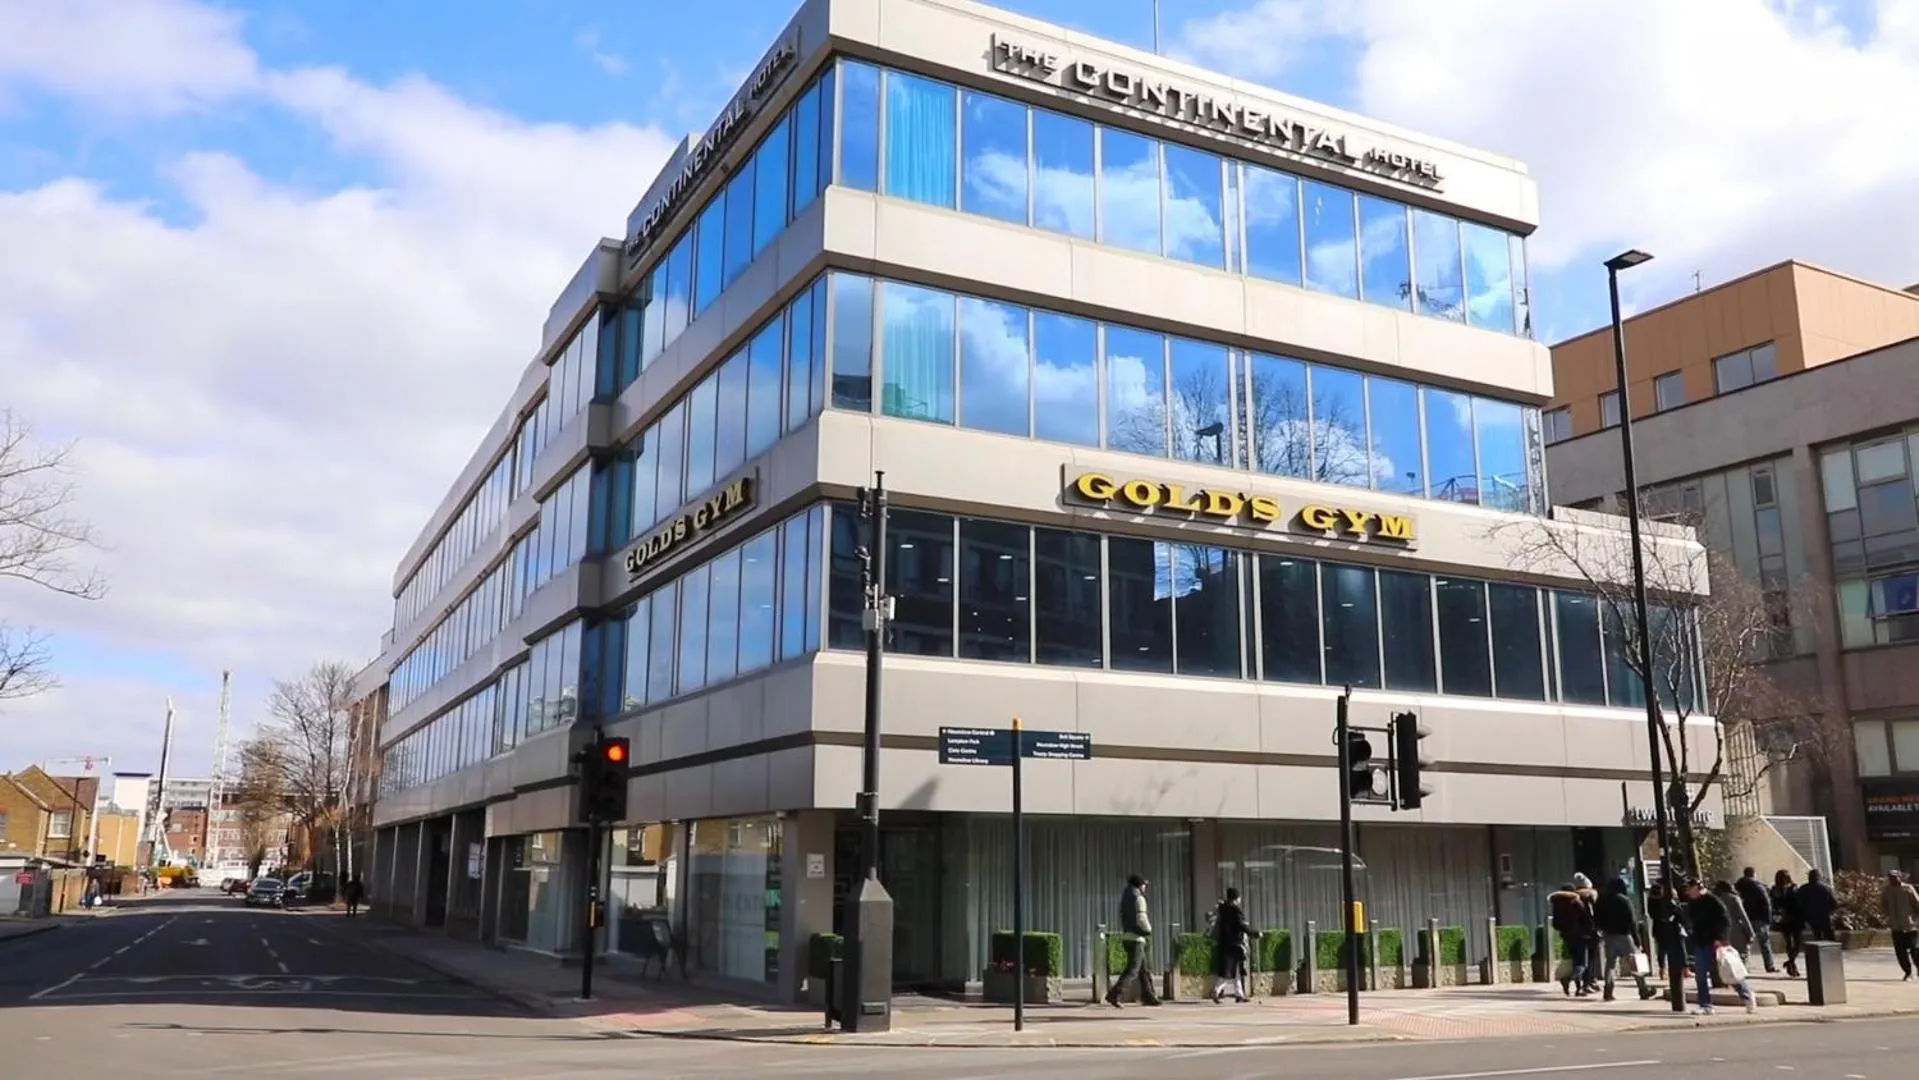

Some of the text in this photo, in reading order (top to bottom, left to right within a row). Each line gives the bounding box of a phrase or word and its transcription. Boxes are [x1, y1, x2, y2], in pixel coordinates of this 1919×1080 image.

[642, 98, 746, 237] CONTINENTAL
[748, 44, 796, 99] HOTEL
[1001, 40, 1444, 181] THE CONTINENTAL HOTEL
[624, 478, 746, 572] GOLD'S GYM
[1076, 471, 1416, 541] GOLD'S GYM
